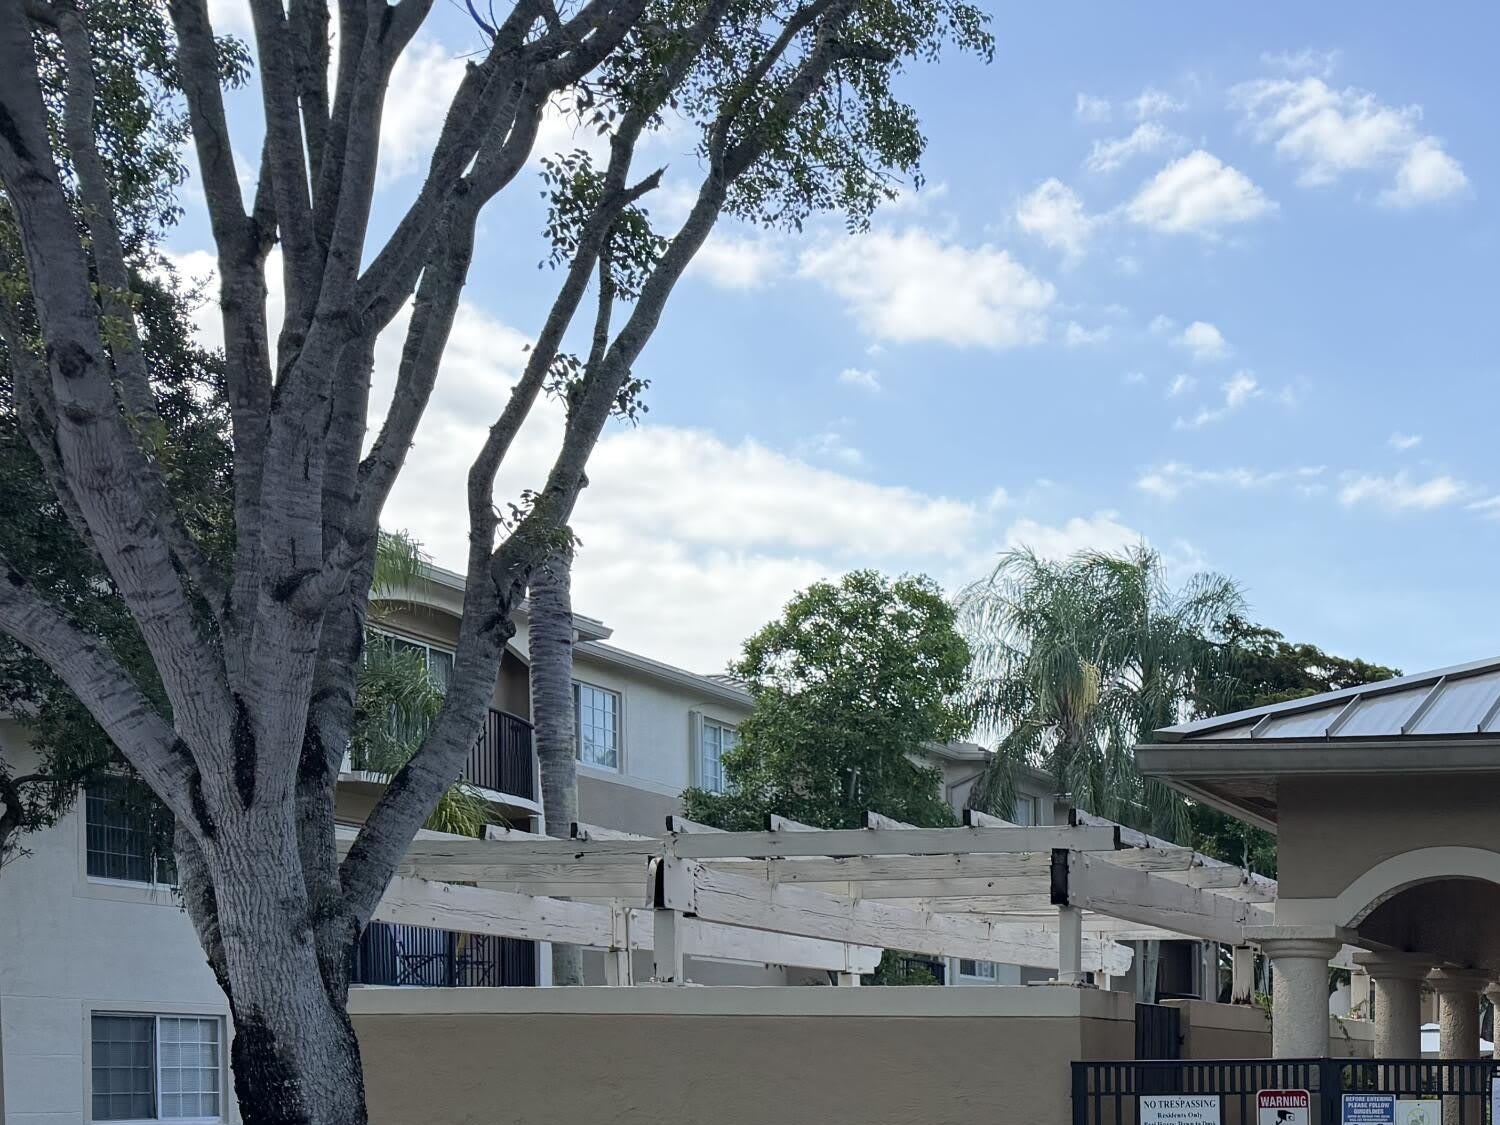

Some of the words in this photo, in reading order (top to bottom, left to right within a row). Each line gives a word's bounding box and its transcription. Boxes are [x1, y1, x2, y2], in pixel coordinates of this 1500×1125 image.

[1144, 1100, 1156, 1109] NO
[1158, 1100, 1216, 1108] TRESPASSING
[1260, 1096, 1307, 1107] WARNING
